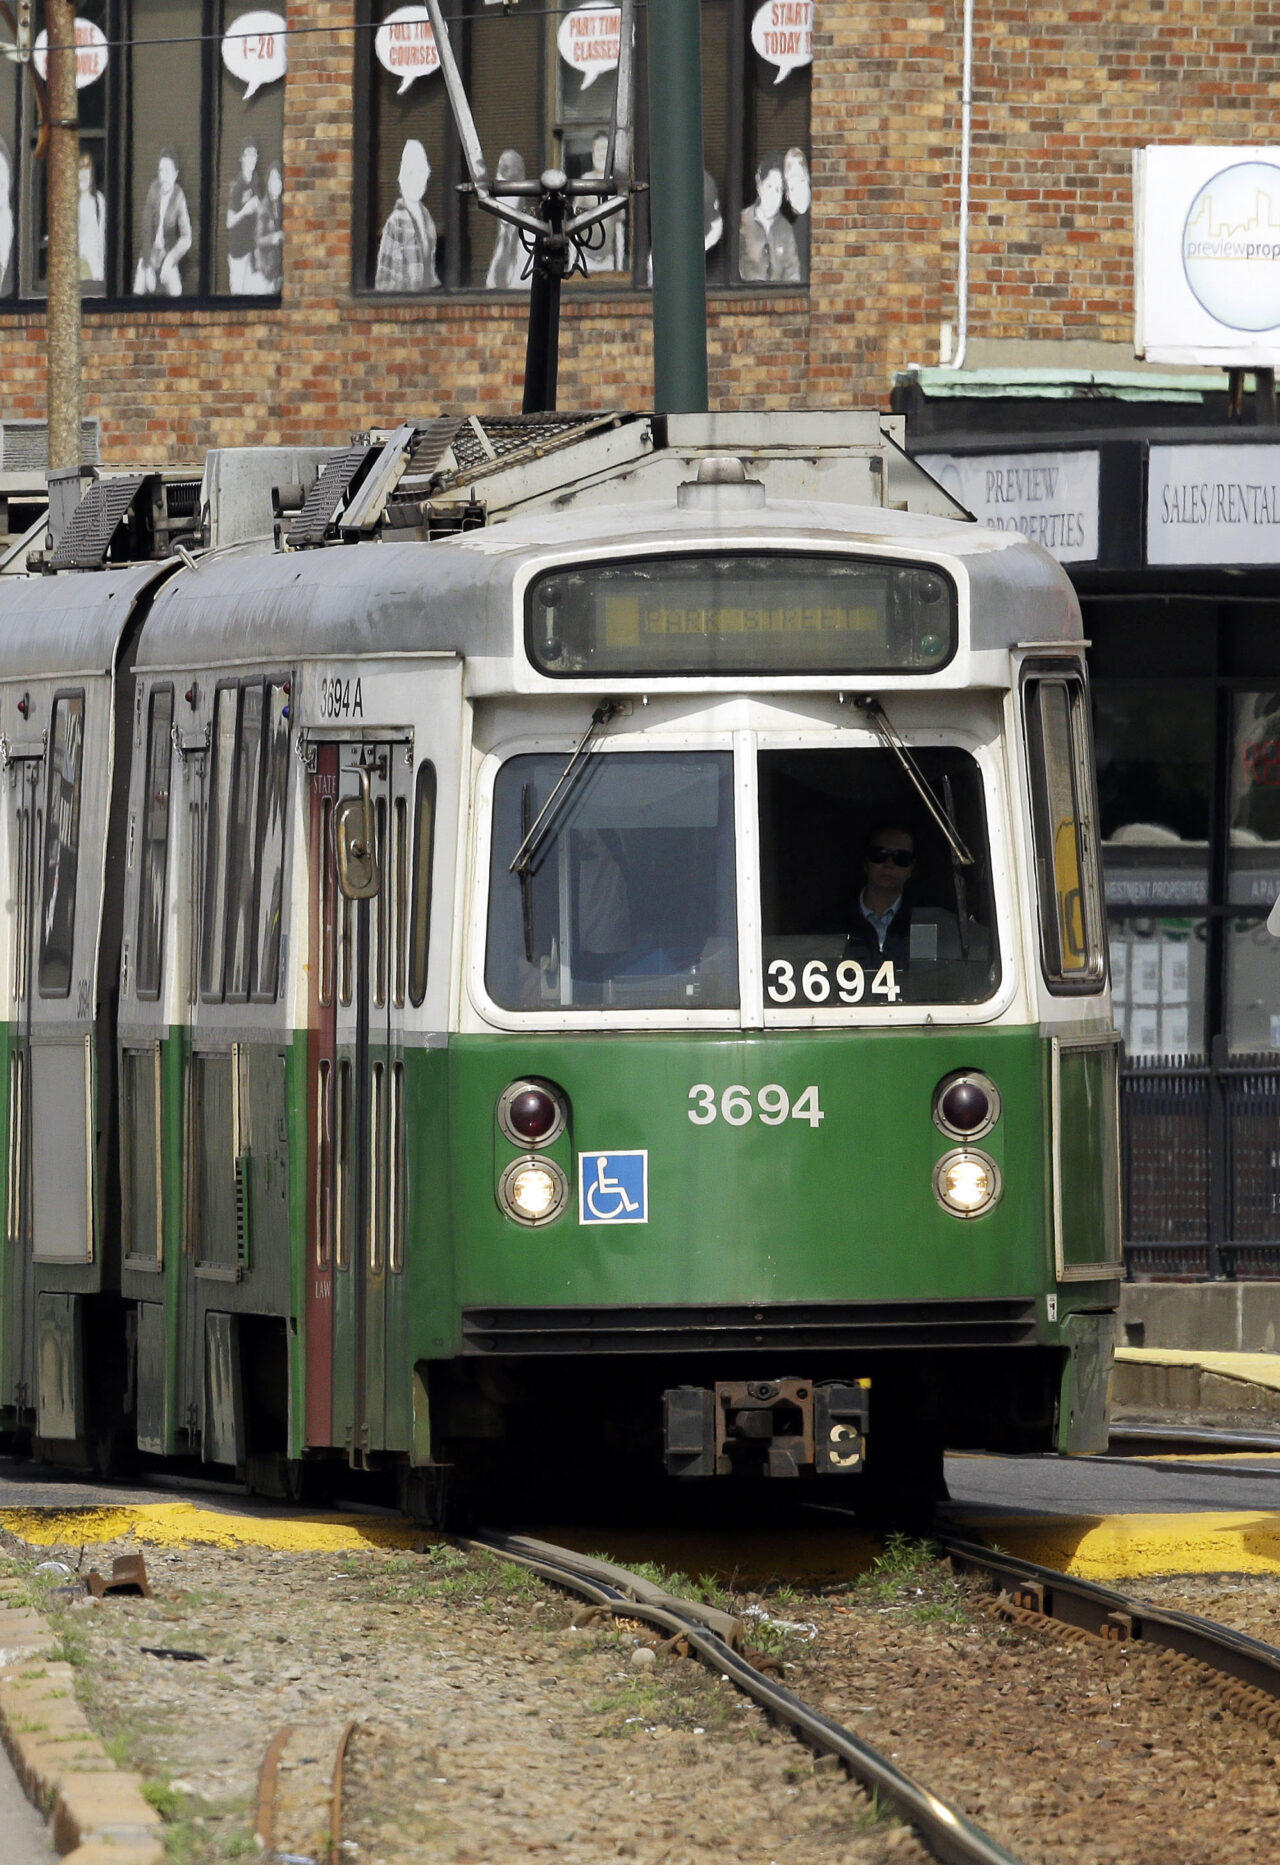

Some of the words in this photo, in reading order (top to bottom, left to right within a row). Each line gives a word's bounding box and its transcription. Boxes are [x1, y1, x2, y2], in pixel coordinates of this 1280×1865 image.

[569, 17, 595, 37] PART
[599, 15, 621, 35] TIM
[772, 3, 810, 26] START
[389, 22, 411, 41] FULL
[414, 21, 433, 40] TIM
[763, 31, 800, 54] TODAY
[242, 34, 275, 59] I-20
[389, 46, 437, 66] COURSES
[573, 40, 619, 62] CLASSES
[985, 466, 1060, 504] PREVIEW
[647, 608, 719, 631] PARK
[313, 775, 337, 794] STATE
[767, 959, 901, 1003] 3694
[687, 1083, 825, 1128] 3694
[315, 1280, 331, 1298] LAW
